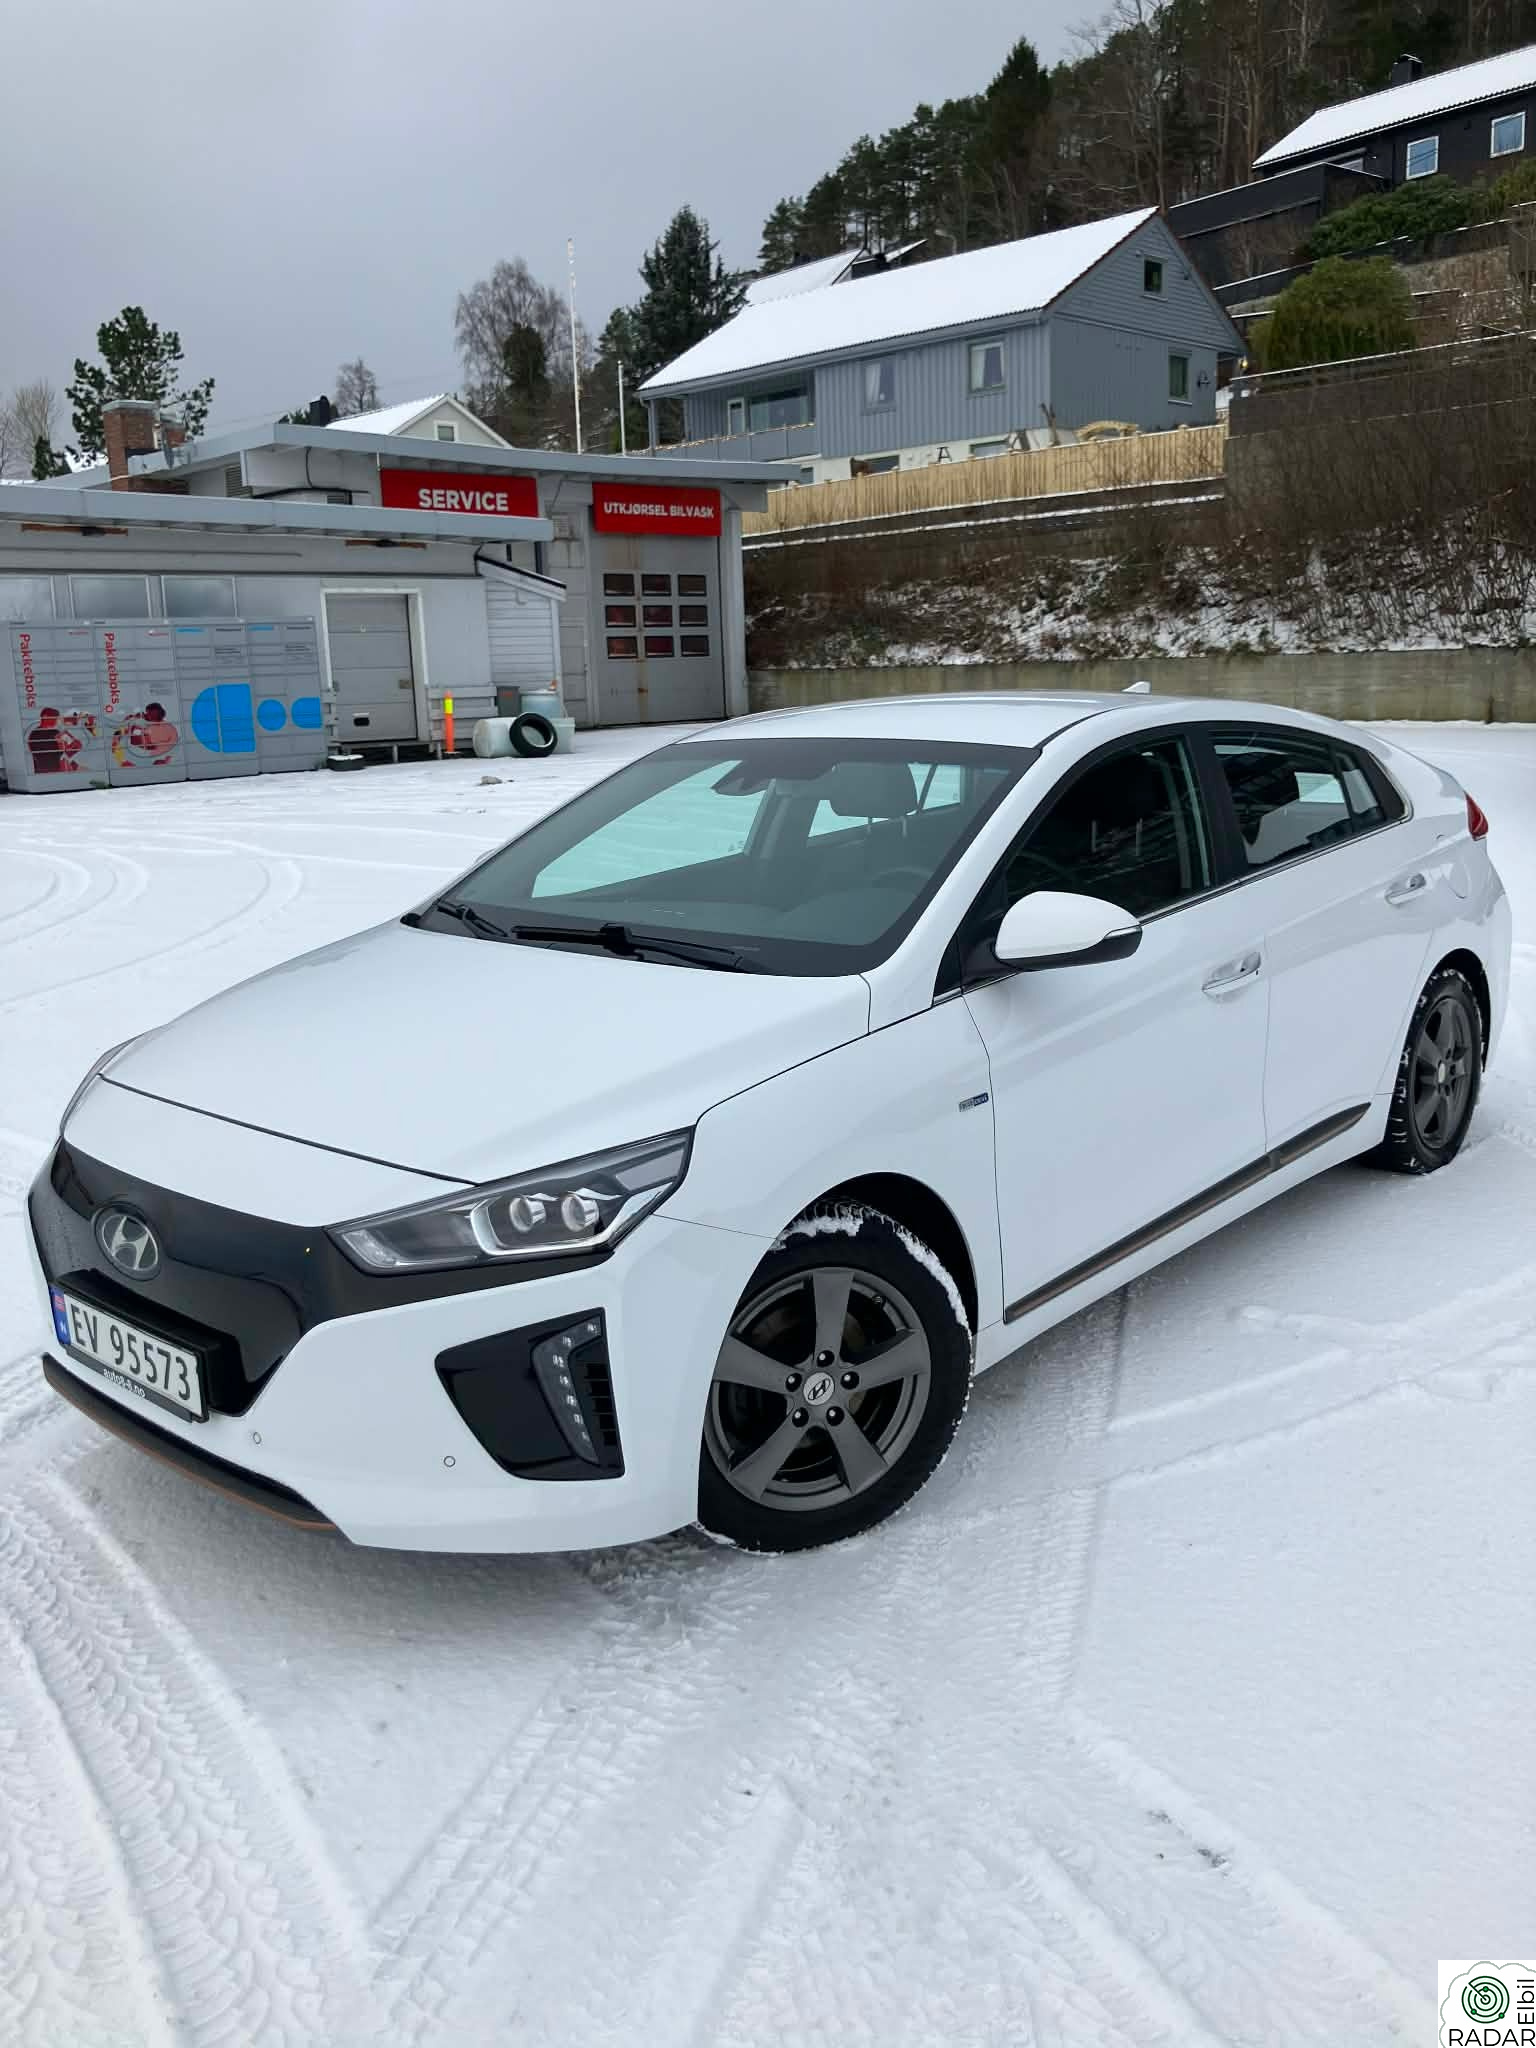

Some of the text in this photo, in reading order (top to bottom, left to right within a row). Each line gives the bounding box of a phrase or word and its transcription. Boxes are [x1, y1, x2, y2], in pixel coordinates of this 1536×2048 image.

[419, 488, 508, 512] SERVICE
[604, 502, 714, 519] UTKJØRSEL BILVASK
[19, 633, 37, 708] Pakkeboks
[104, 632, 120, 704] Pakkeboks
[71, 1303, 191, 1401] EV 95573
